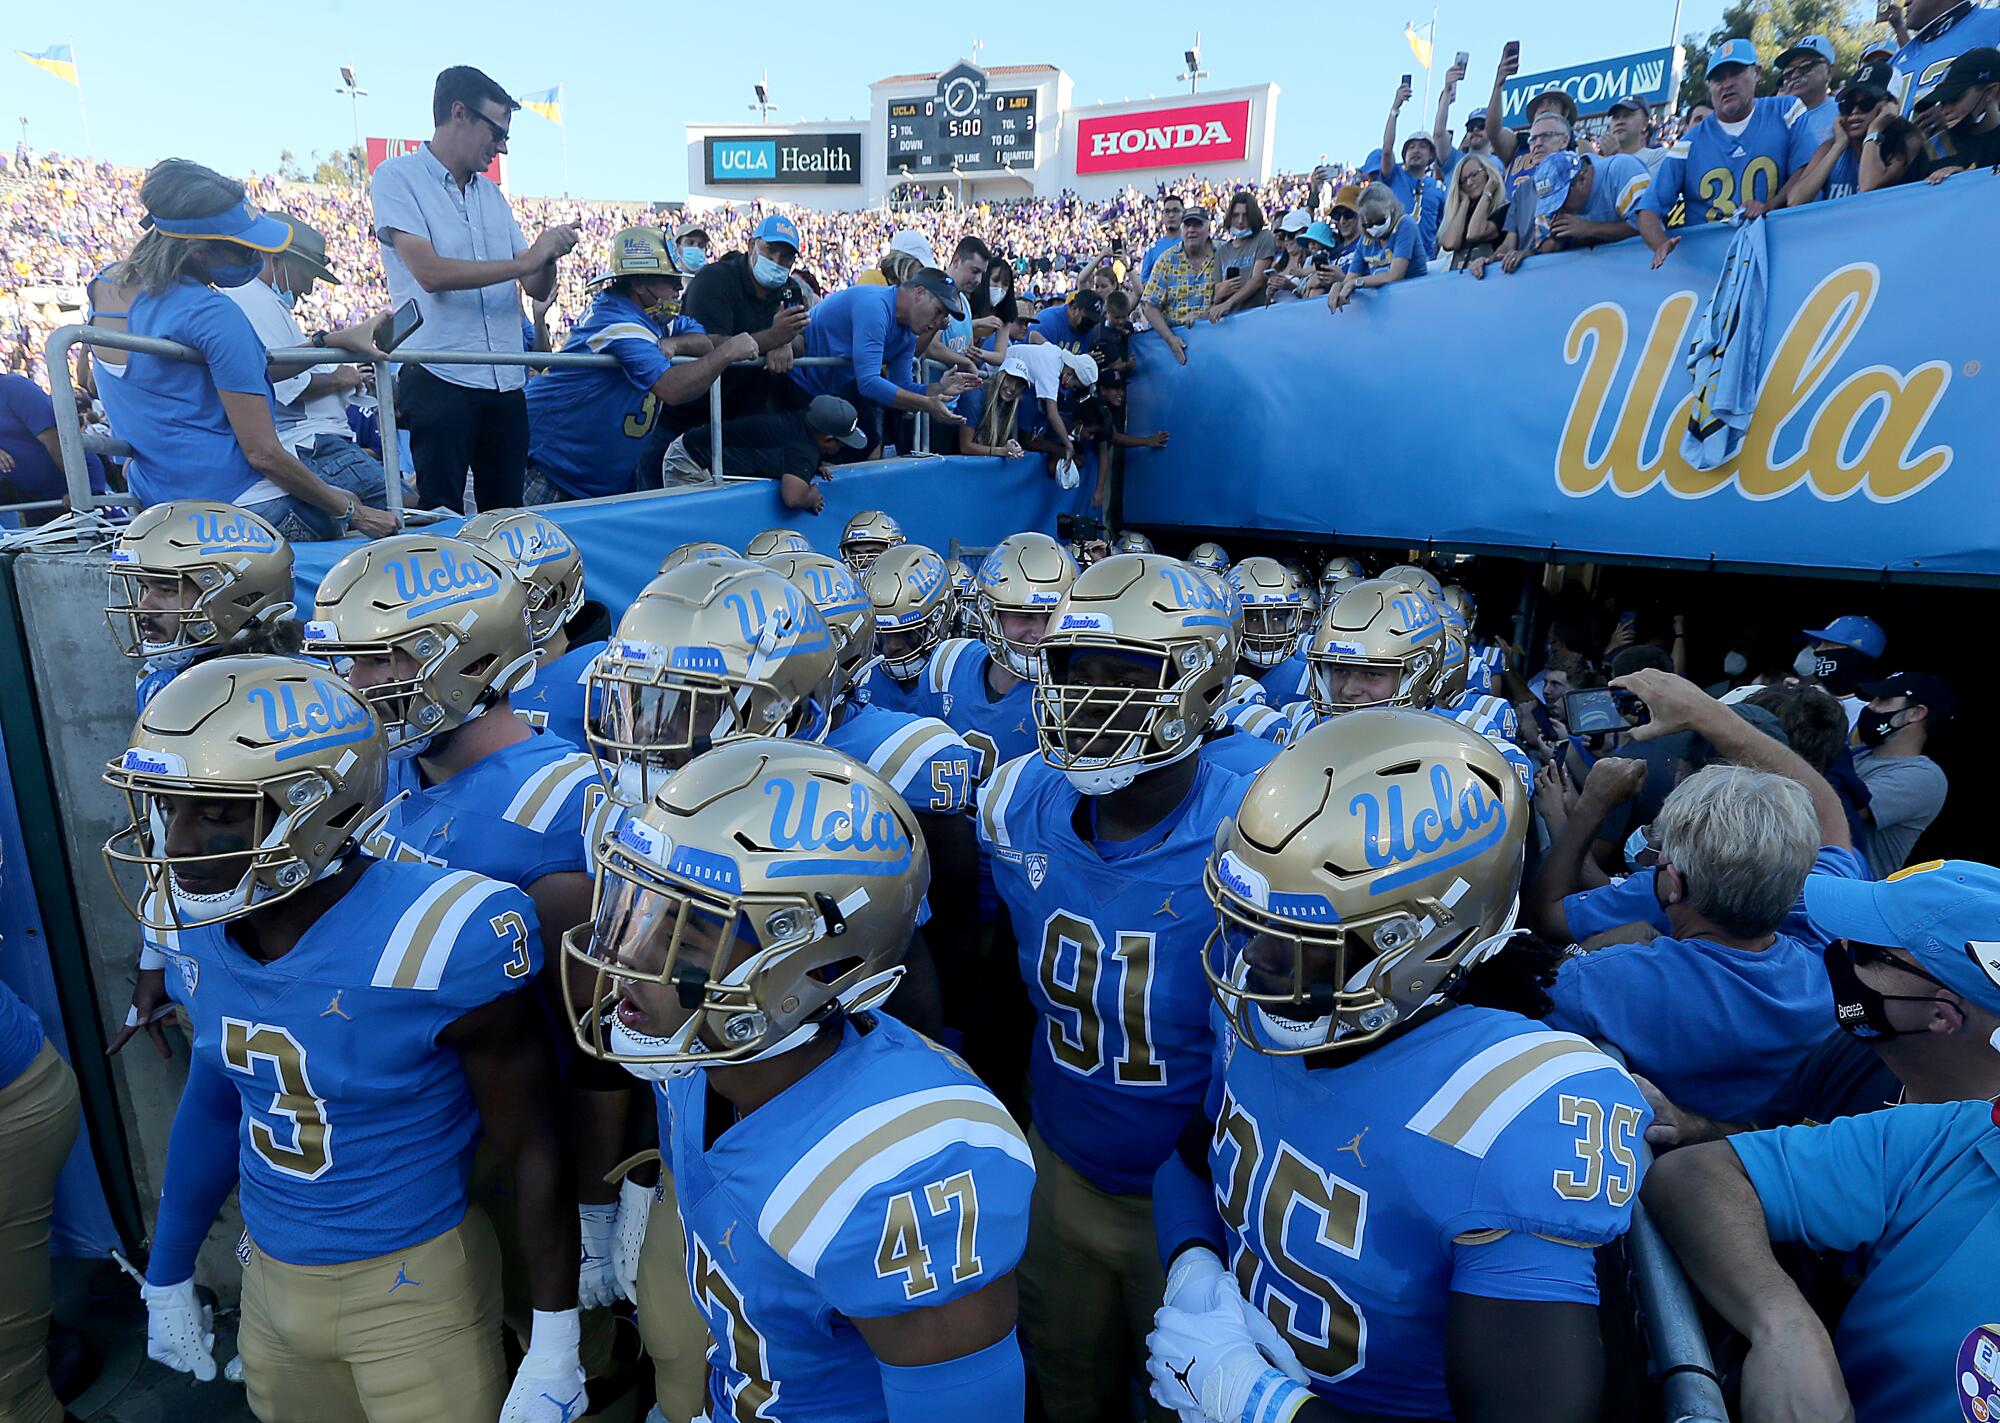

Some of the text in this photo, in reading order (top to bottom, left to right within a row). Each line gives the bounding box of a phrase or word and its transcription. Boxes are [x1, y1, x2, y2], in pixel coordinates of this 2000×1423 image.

[893, 102, 933, 116] UCLA 0
[997, 97, 1004, 111] 0
[890, 125, 913, 138] 3 TOL
[950, 119, 981, 137] 5:00
[1002, 116, 1034, 130] TOL 3
[900, 140, 923, 150] DOWN
[992, 135, 1015, 145] TO GO
[1091, 121, 1231, 156] HONDA
[722, 147, 851, 171] UCLA Health
[922, 156, 931, 165] ON
[965, 153, 980, 163] LINE
[1002, 151, 1033, 161] QUARTER
[1700, 156, 1778, 222] 30
[189, 514, 276, 549] Ucla
[500, 523, 571, 564] Ucla
[384, 550, 498, 608] Ucla
[1061, 615, 1101, 629] Bruins
[677, 657, 719, 668] JORDAN
[247, 678, 374, 752] Ucla
[124, 751, 168, 775] Bruins
[931, 759, 969, 811] 57
[764, 778, 908, 864] Ucla
[1350, 764, 1502, 882] Ucla
[618, 820, 652, 854] Bruins
[677, 861, 732, 883] JORDAN
[1030, 869, 1041, 882] 12
[1219, 858, 1252, 898] Bruins
[1275, 905, 1326, 916] JORDAN
[489, 910, 531, 979] 3
[1037, 908, 1167, 1087] 91
[221, 1016, 333, 1181] 3
[1553, 1094, 1643, 1208] 35
[873, 1169, 983, 1301] 47
